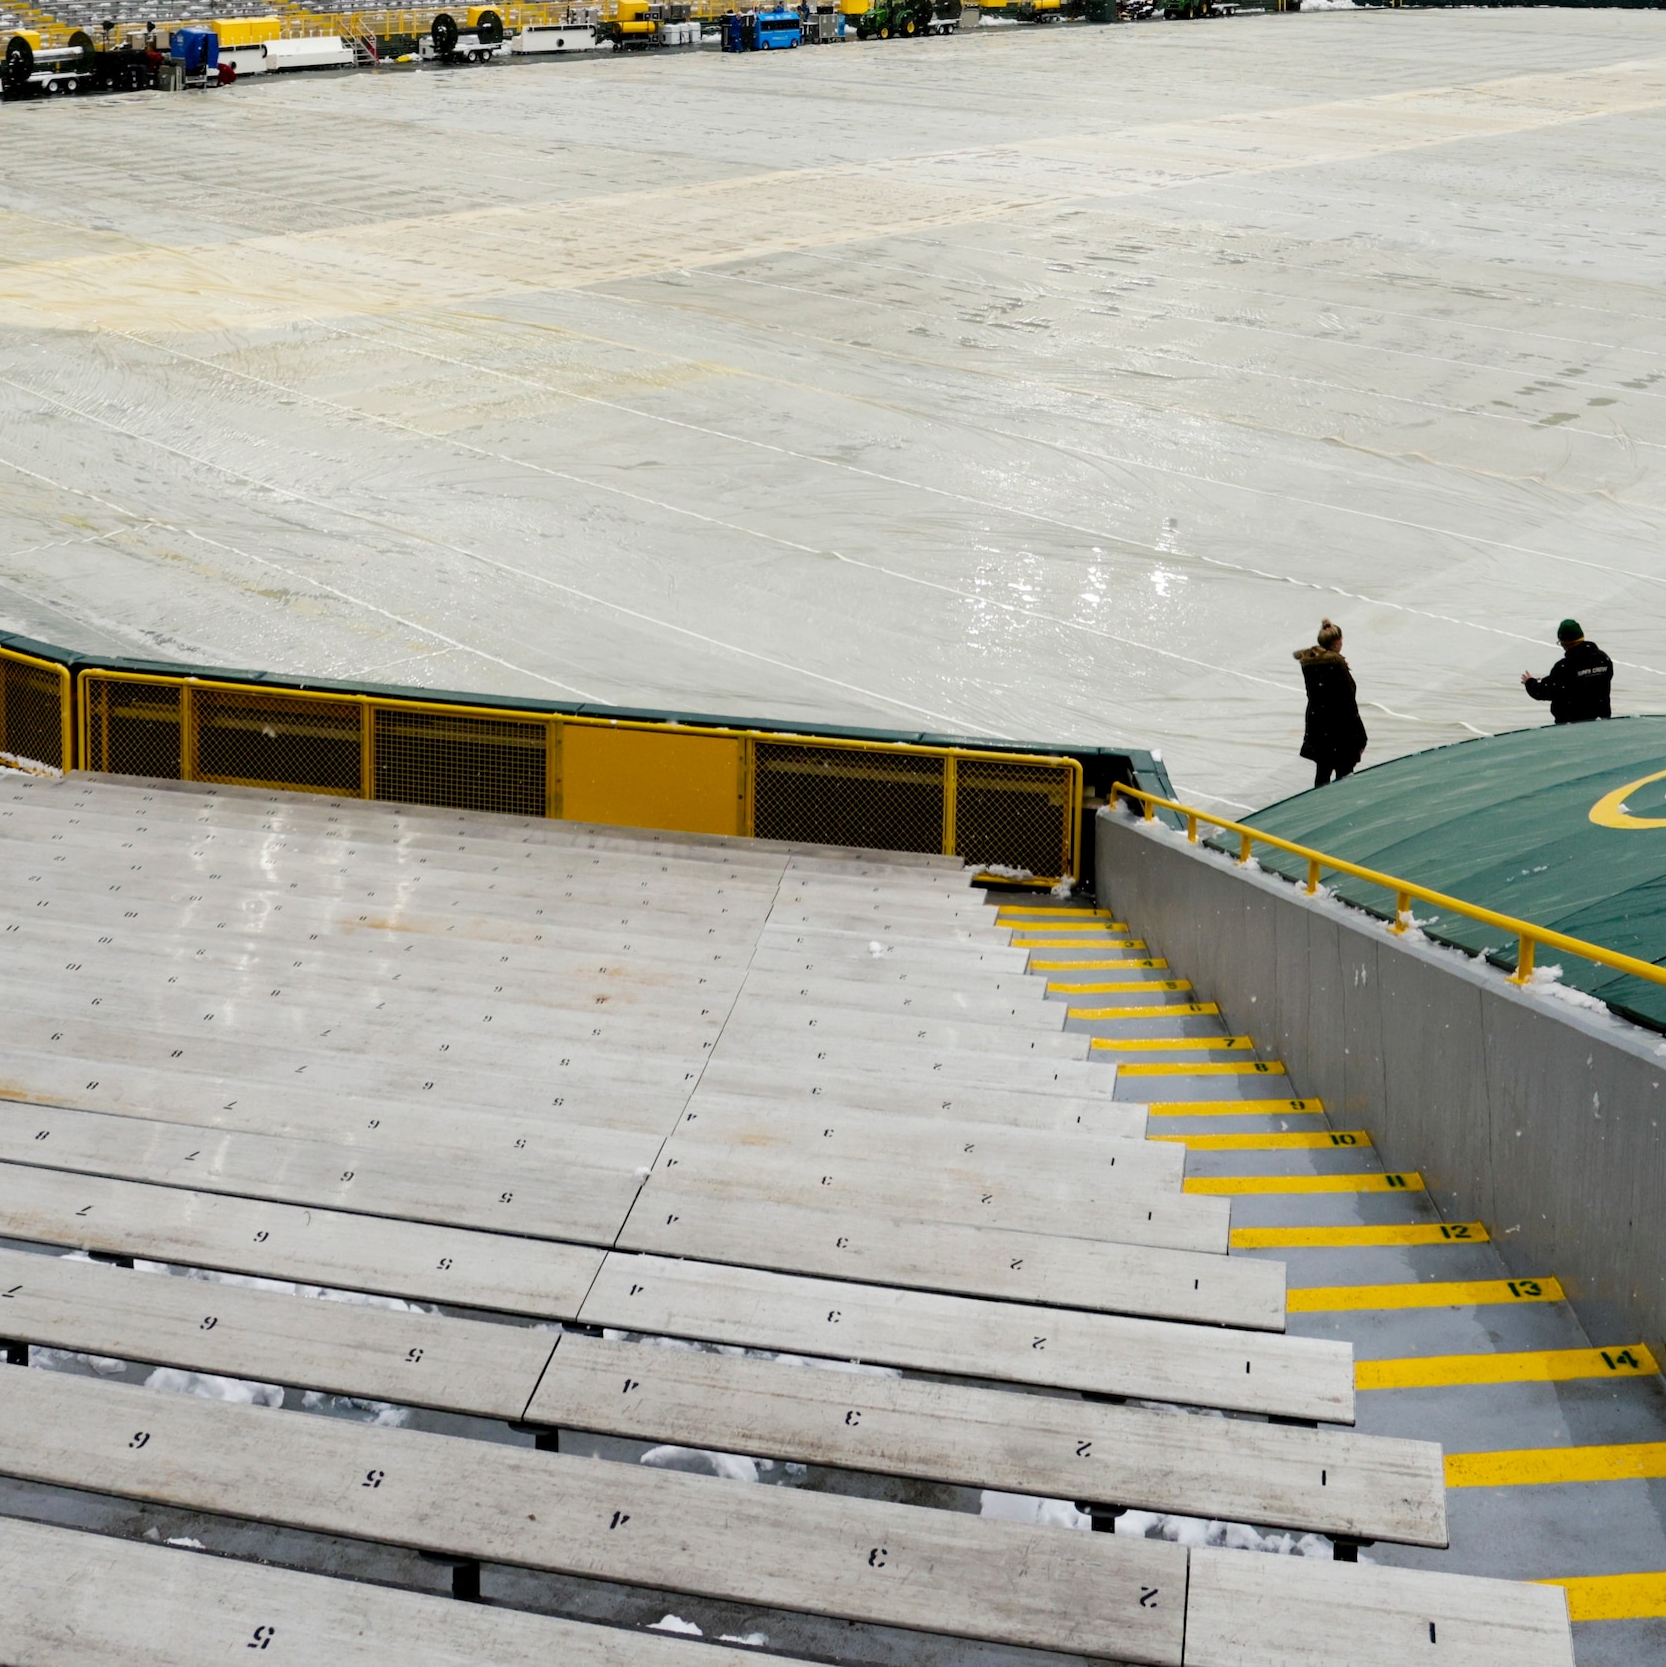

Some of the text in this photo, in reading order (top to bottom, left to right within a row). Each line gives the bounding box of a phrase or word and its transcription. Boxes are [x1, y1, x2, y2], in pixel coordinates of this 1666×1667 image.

[1224, 1039, 1235, 1048] 7
[1255, 1063, 1269, 1073] 8
[1290, 1100, 1305, 1110] 9
[1330, 1134, 1357, 1145] 10
[1385, 1175, 1407, 1187] 11
[1440, 1225, 1472, 1239] 12
[1508, 1281, 1542, 1298] 13
[1601, 1350, 1638, 1370] 14
